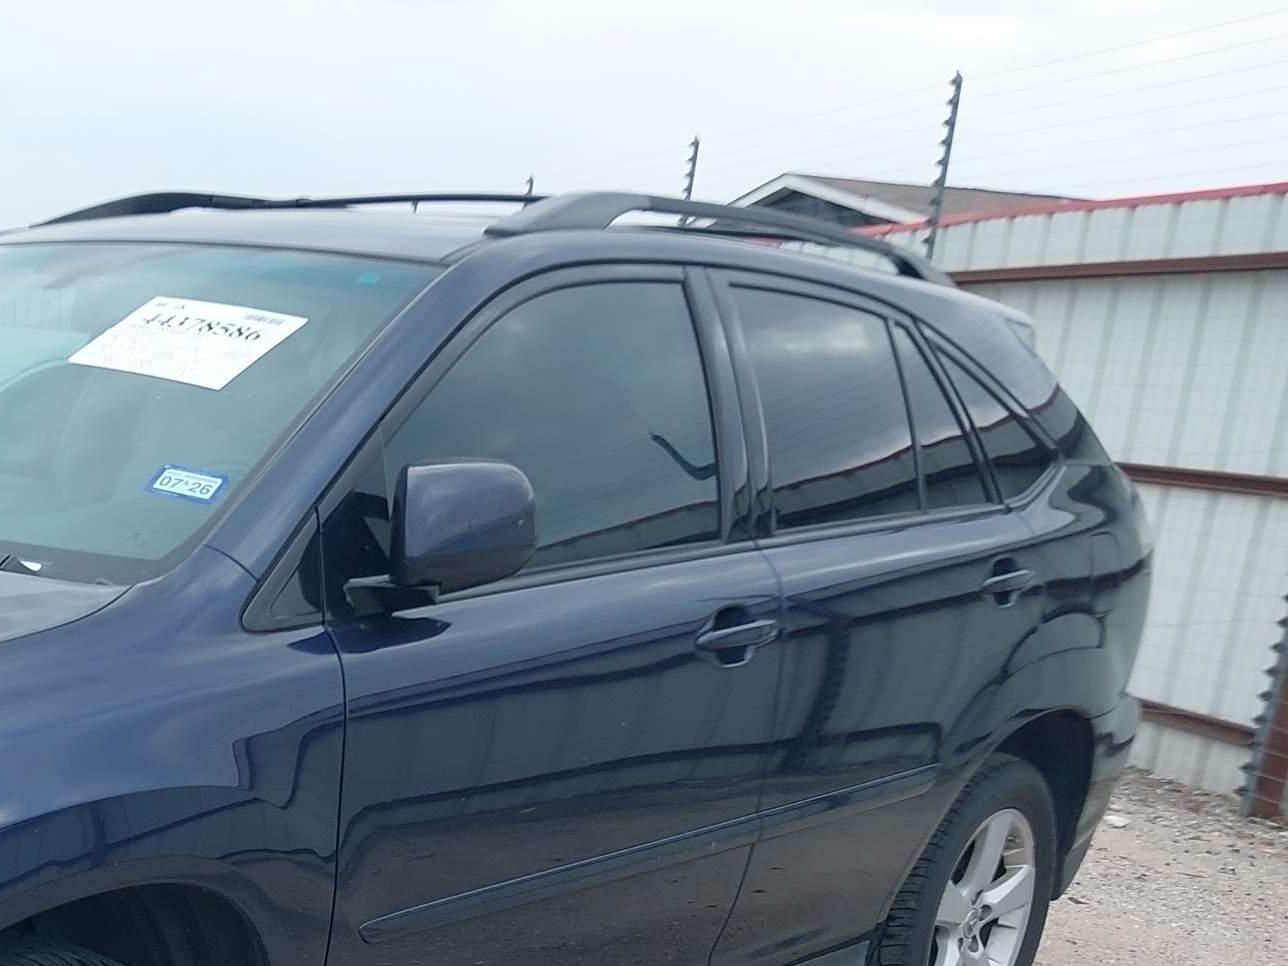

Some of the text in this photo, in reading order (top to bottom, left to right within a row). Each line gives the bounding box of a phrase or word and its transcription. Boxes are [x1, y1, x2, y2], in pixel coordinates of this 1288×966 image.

[143, 312, 263, 341] 44378586
[159, 476, 184, 489] 07
[188, 482, 213, 496] 26
